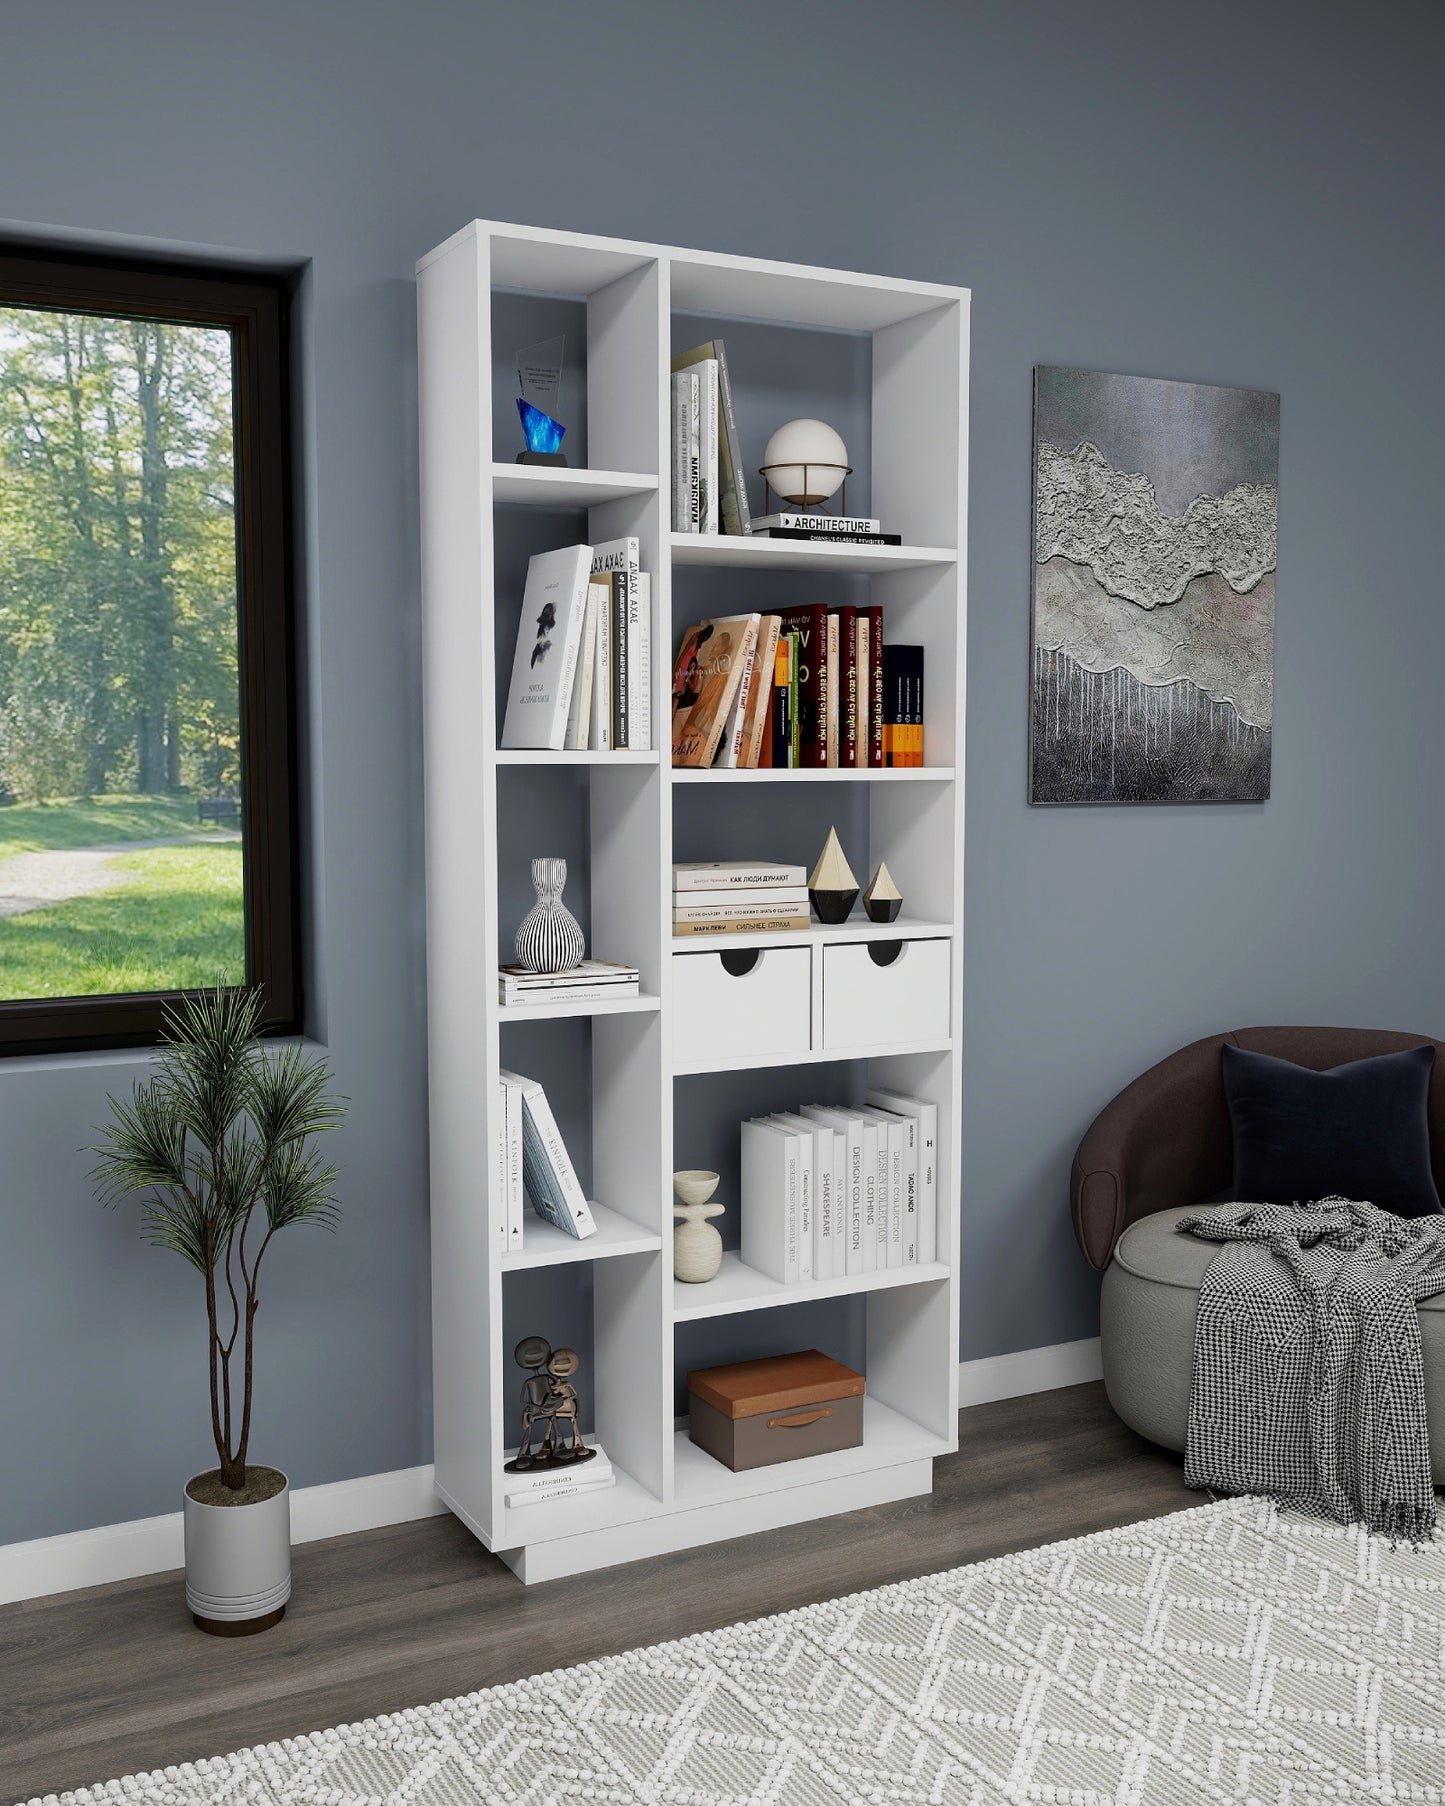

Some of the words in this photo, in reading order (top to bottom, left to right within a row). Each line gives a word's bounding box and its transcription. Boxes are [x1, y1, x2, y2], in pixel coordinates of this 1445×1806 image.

[794, 517, 871, 532] ARCHITECTURE
[743, 875, 762, 883] ЛЮДИ
[763, 874, 789, 882] ДУМАЮТ
[511, 1140, 519, 1183] KINFOLK
[548, 1138, 569, 1177] KINFOLK
[926, 1139, 933, 1147] H
[852, 1146, 861, 1184] DESIGN
[878, 1150, 888, 1184] DESIGN
[802, 1169, 810, 1208] Constructing
[837, 1179, 843, 1191] MY
[823, 1173, 831, 1238] SHAKESPEARE
[852, 1186, 860, 1250] COLLECTION
[878, 1186, 887, 1243] COLLECTION
